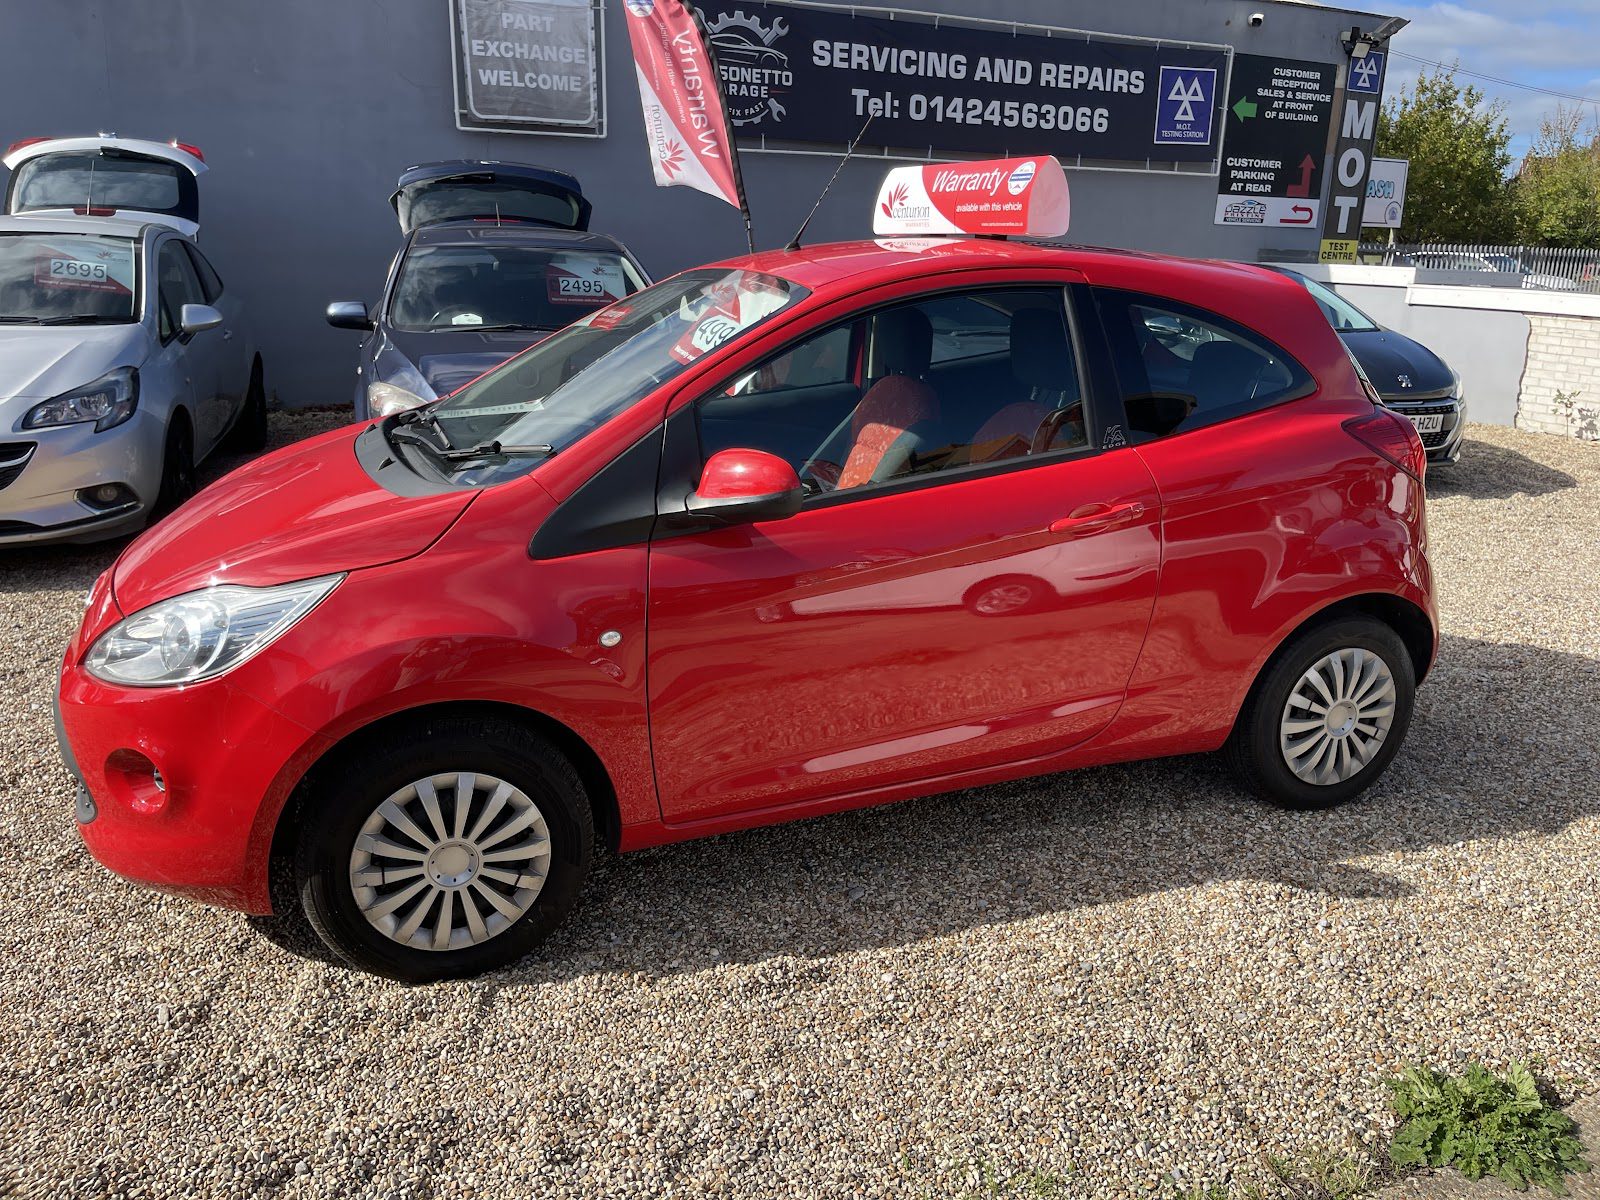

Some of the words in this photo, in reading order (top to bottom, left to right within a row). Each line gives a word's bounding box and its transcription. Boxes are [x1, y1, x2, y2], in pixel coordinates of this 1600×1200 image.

[501, 12, 554, 33] PART
[471, 38, 586, 65] EXCHANGE
[812, 40, 968, 80] SERVICING
[973, 57, 1033, 86] AND
[1039, 63, 1146, 95] REPAIRS
[1273, 67, 1321, 80] CUSTOMER
[478, 69, 583, 93] WELCOME
[1271, 78, 1320, 91] RECEPTION
[1257, 87, 1285, 98] SALES
[1286, 90, 1294, 99] &
[1295, 91, 1331, 103] SERVICE
[745, 101, 764, 116] FAST
[851, 89, 899, 120] Tel:
[908, 94, 1110, 134] 01424563066
[1272, 100, 1283, 109] AT
[1285, 101, 1314, 111] FRONT
[1264, 111, 1277, 119] OF
[1278, 112, 1319, 123] BUILDING
[1161, 130, 1183, 138] TESTING
[1226, 157, 1282, 169] CUSTOMER
[932, 167, 1008, 197] Warranty
[1230, 170, 1275, 181] PARKING
[1230, 182, 1244, 192] AT
[1245, 182, 1272, 193] REAR
[1365, 179, 1395, 200] ASH
[893, 206, 930, 218] centurion
[956, 203, 979, 212] available
[980, 203, 991, 211] with
[991, 202, 1001, 211] this
[1002, 202, 1023, 211] vehicle
[1328, 242, 1350, 251] TEST
[1321, 251, 1353, 261] CENTRE
[52, 261, 105, 279] 2695
[561, 279, 603, 293] 2495
[1418, 416, 1439, 430] HZU
